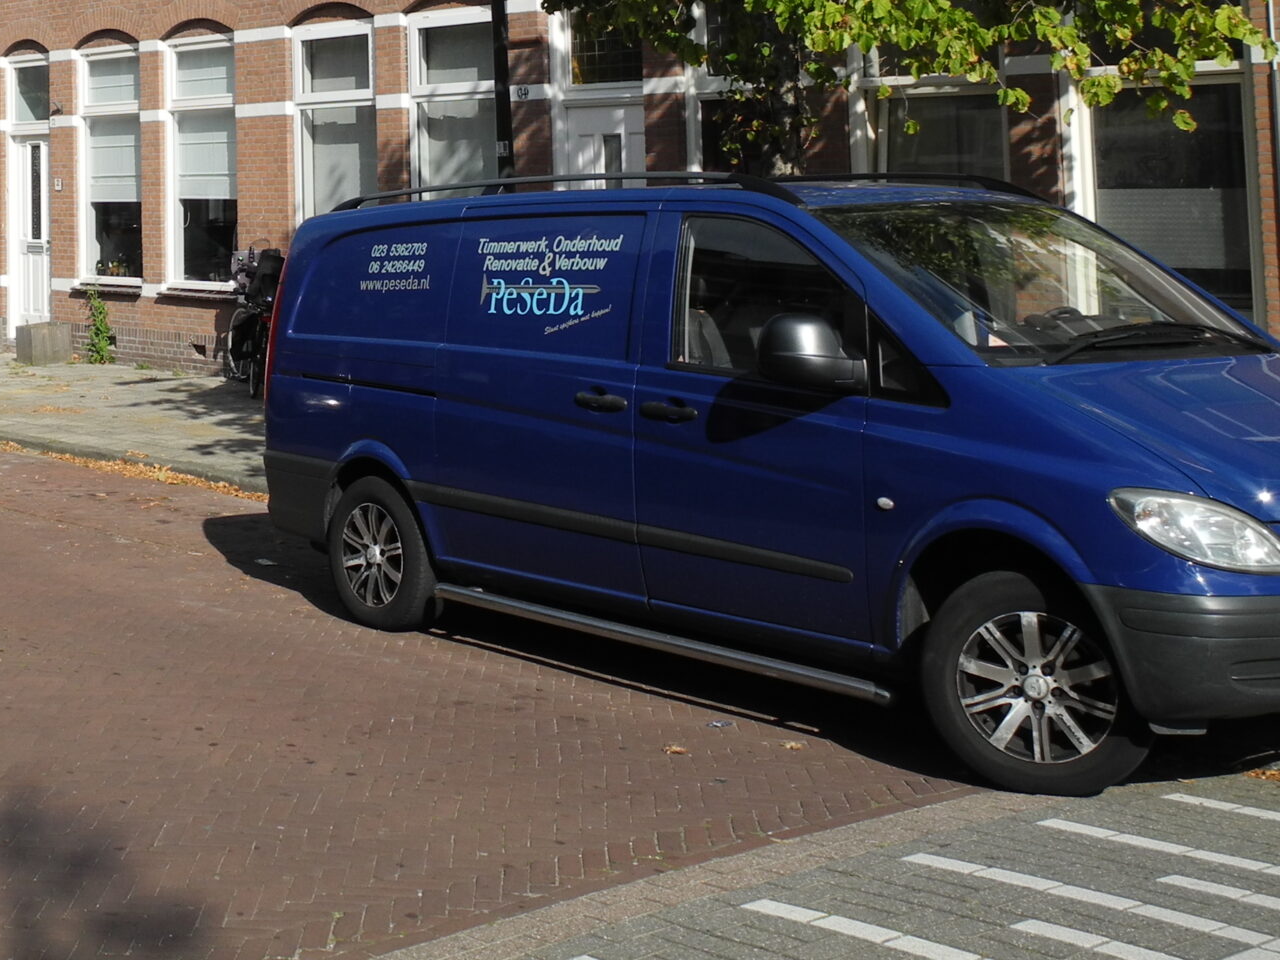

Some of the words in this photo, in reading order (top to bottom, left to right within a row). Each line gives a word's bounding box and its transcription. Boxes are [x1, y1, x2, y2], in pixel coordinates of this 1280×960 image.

[371, 244, 389, 257] 023
[389, 242, 428, 256] 5362703
[477, 236, 550, 254] Timmerwerk,
[553, 234, 624, 252] Onderhoud
[368, 261, 380, 274] 06
[381, 259, 425, 273] 24266449
[483, 255, 539, 271] Renovatie
[539, 252, 554, 277] &
[555, 254, 608, 270] Verbouw
[360, 274, 430, 293] www.peseda.nl
[488, 277, 585, 316] PeSeDa
